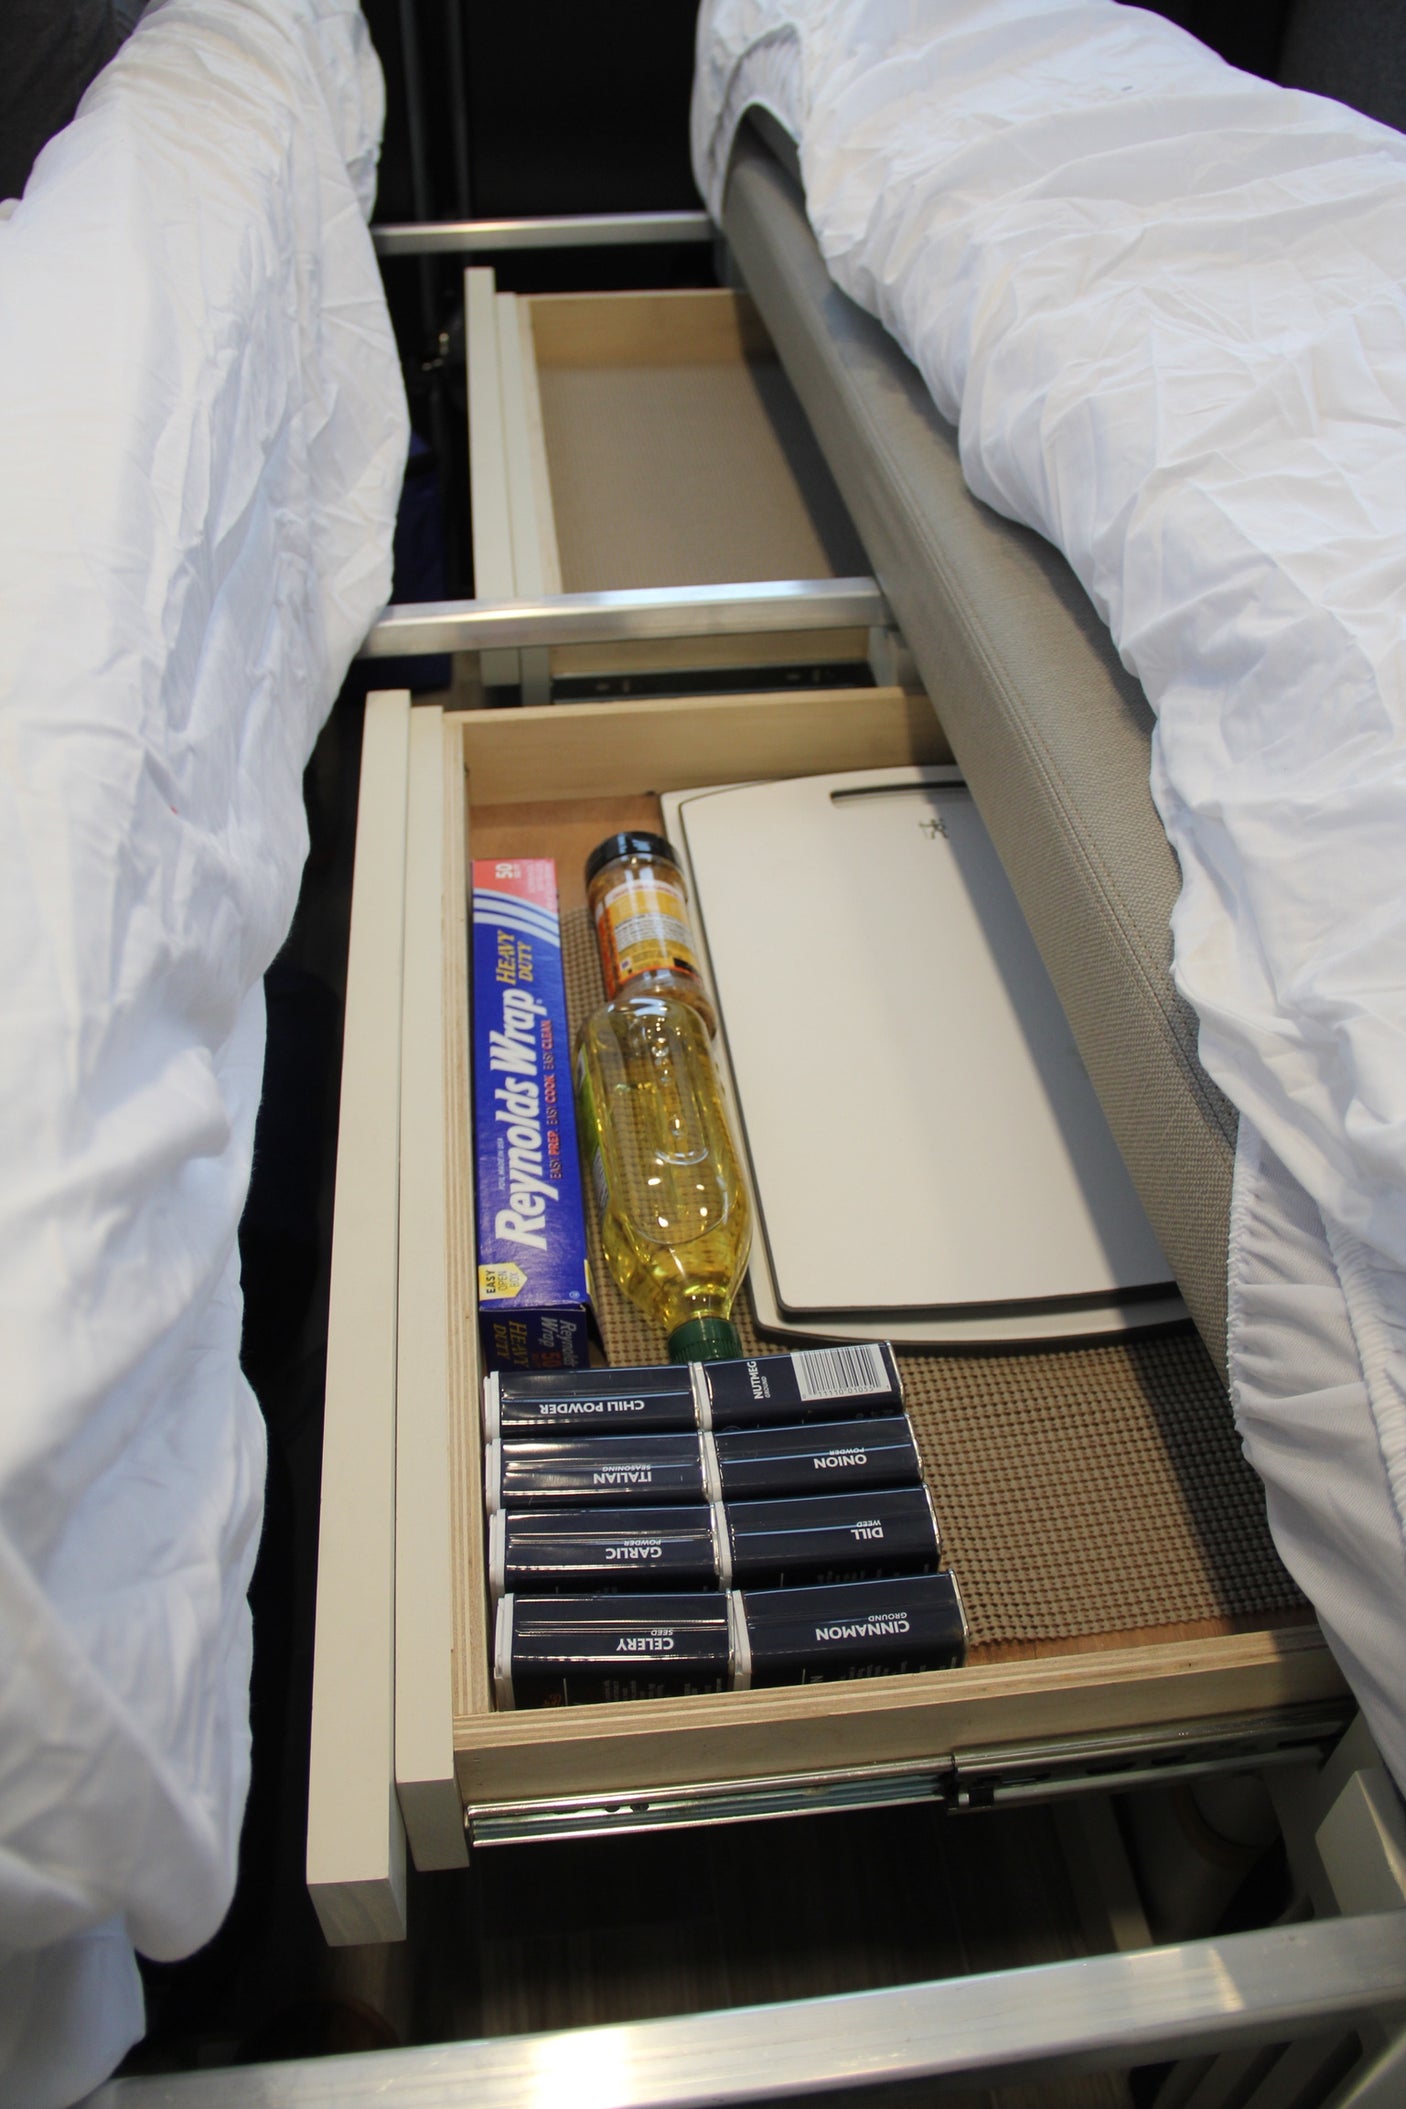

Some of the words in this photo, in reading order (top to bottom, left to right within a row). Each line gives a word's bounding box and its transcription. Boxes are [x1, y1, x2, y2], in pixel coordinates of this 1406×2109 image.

[495, 863, 513, 880] 50
[496, 929, 517, 985] HEAVY
[517, 941, 534, 982] DUTY
[489, 988, 548, 1077] Wrap
[495, 1077, 559, 1251] Reynolds
[486, 1270, 496, 1294] EASY
[497, 1271, 508, 1292] OPEN
[509, 1271, 519, 1288] BOX
[493, 1323, 510, 1359] DUTY
[538, 1317, 558, 1348] Wrap
[509, 1321, 529, 1368] HEAVY
[747, 1360, 764, 1399] NUTMEG
[760, 1376, 771, 1398] GROUND
[539, 1402, 603, 1415] POWDER
[607, 1400, 645, 1412] CHILI
[829, 1447, 865, 1455] POWDER
[602, 1464, 651, 1472] SEASONING
[813, 1454, 867, 1469] ONION
[593, 1471, 652, 1484] ITALIAN
[856, 1519, 881, 1527] WEED
[851, 1526, 884, 1540] DILL
[605, 1547, 662, 1559] GARLIC
[867, 1612, 907, 1622] GROUND
[815, 1620, 910, 1641] CINNAMON
[616, 1637, 674, 1651] CELERY
